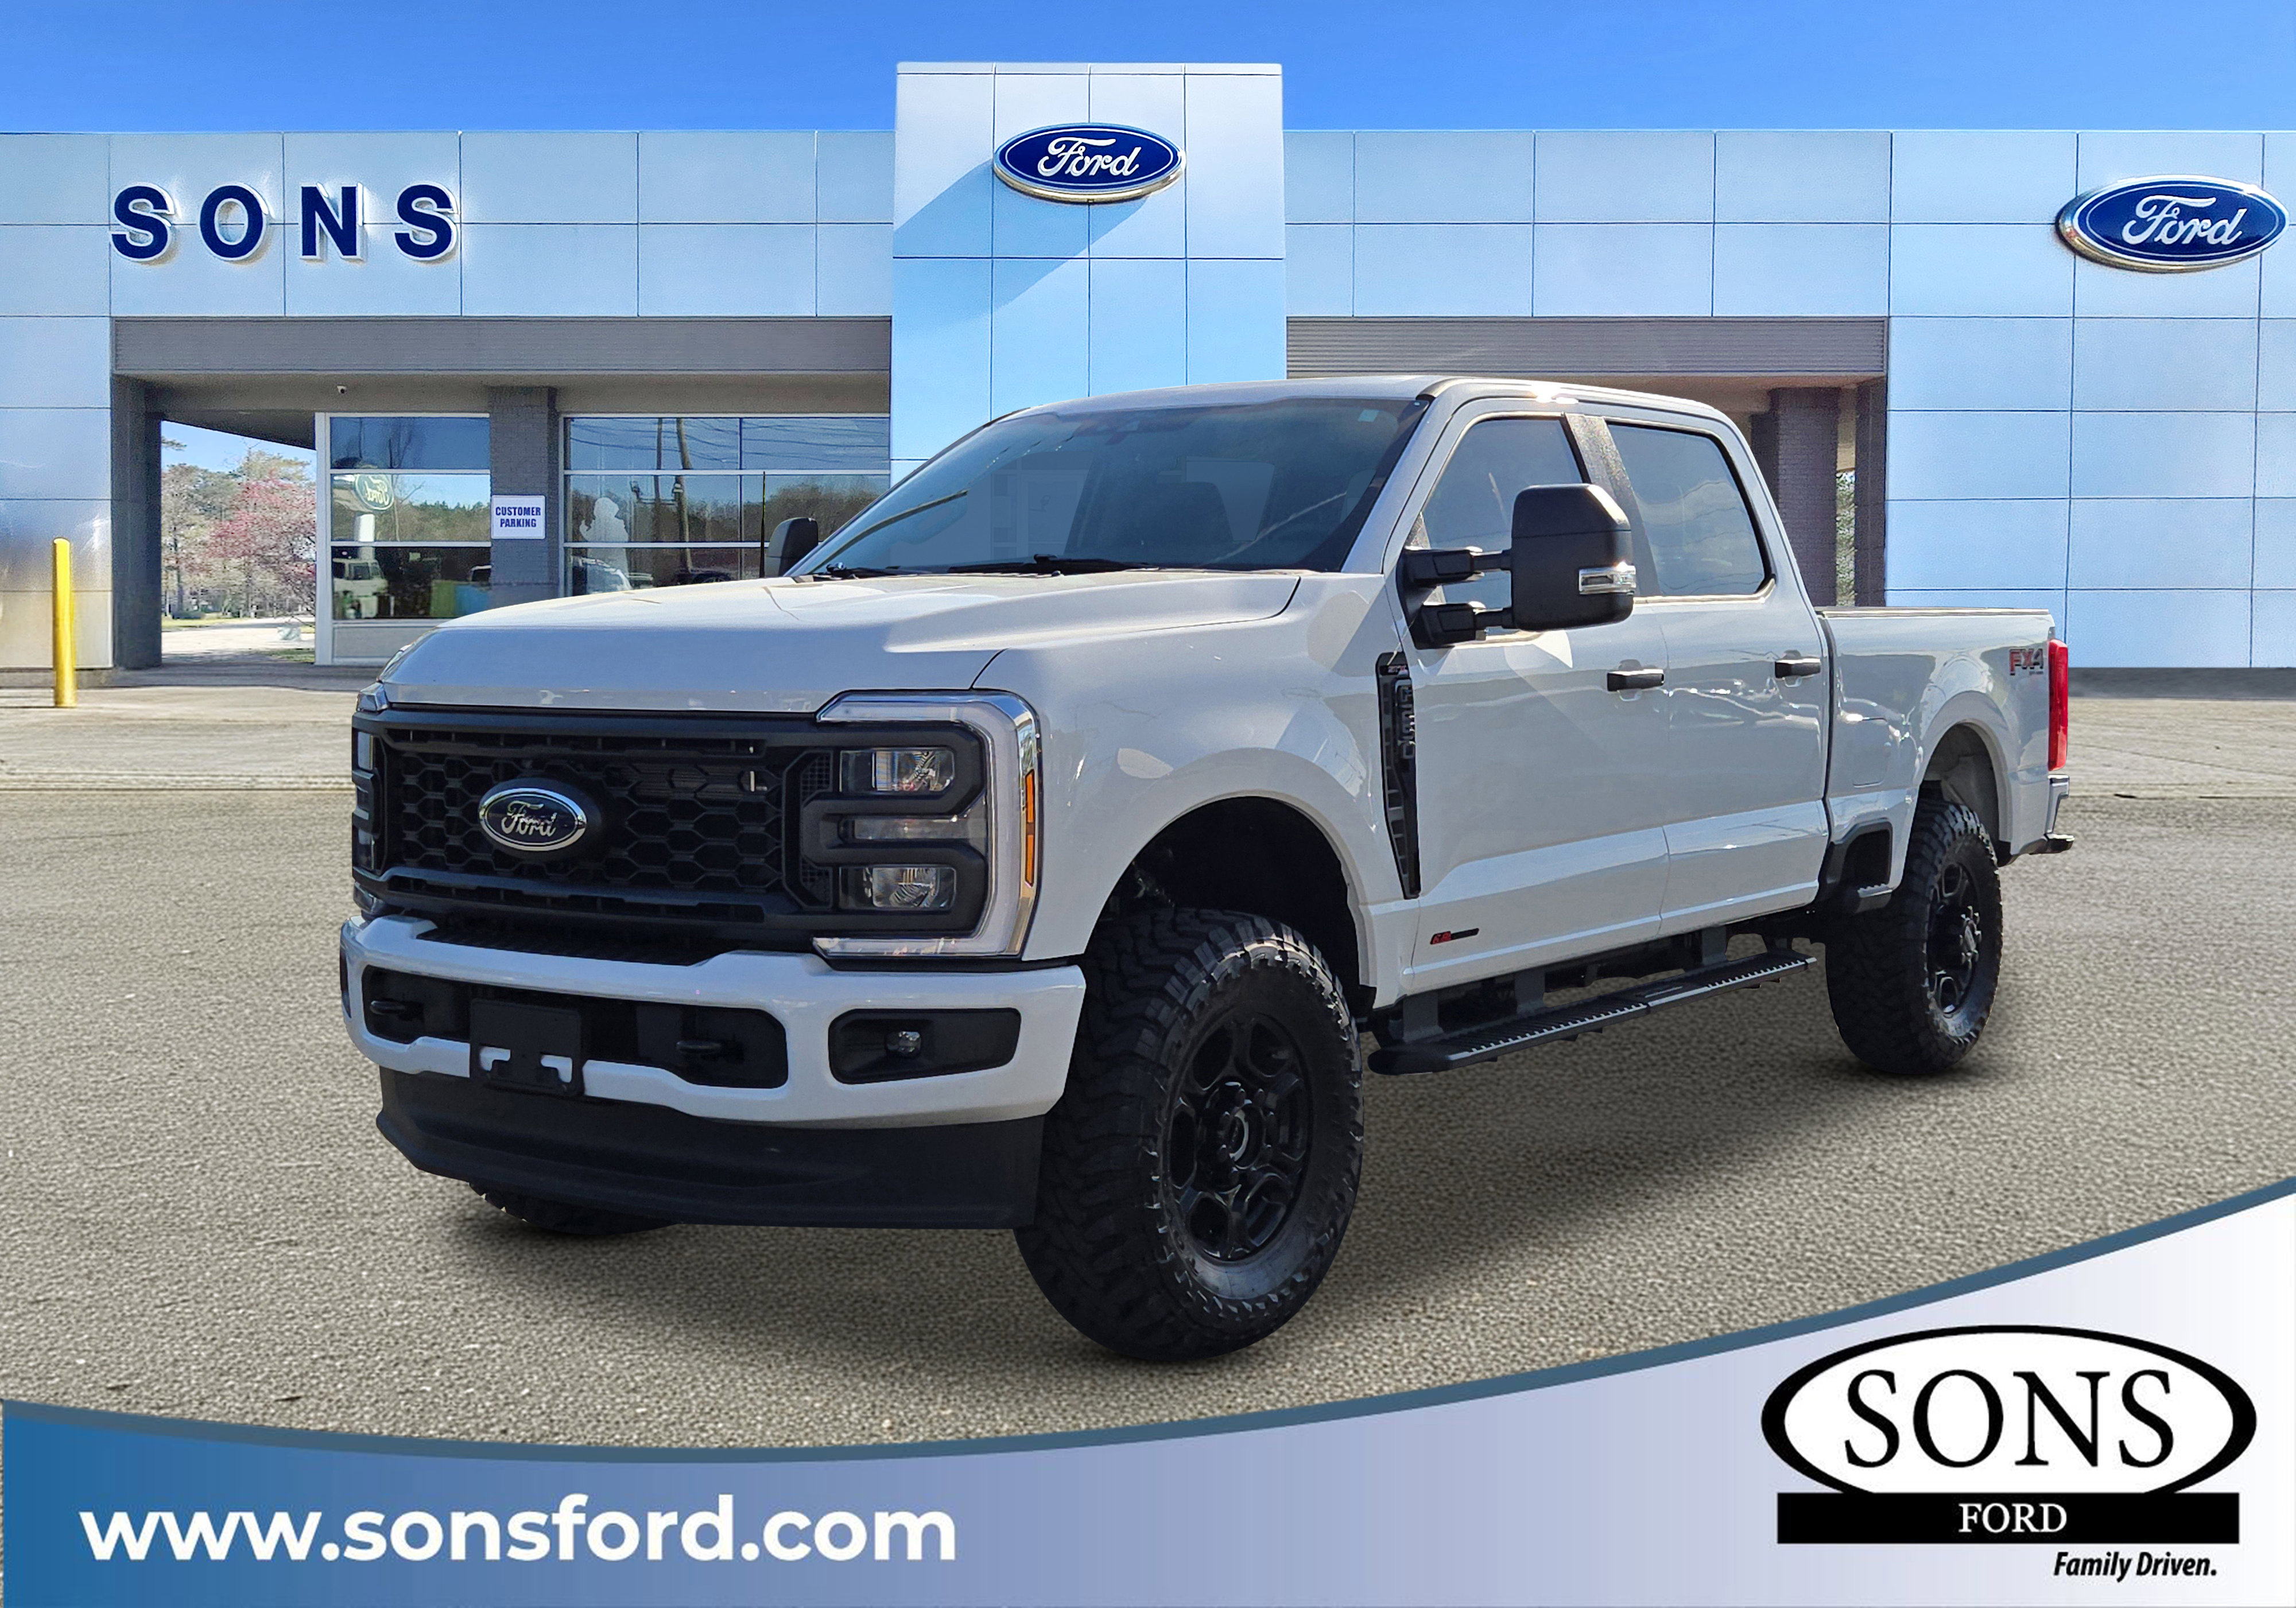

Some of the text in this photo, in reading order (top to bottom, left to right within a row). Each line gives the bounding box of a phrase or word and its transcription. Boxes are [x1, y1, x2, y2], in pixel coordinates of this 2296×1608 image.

[1037, 137, 1141, 177] Ford
[111, 184, 457, 261] SONS
[2122, 195, 2247, 246] Ford
[495, 506, 541, 516] CUSTOMER
[500, 518, 537, 527] PARKING
[2010, 648, 2043, 676] FX4
[501, 800, 558, 837] Ford
